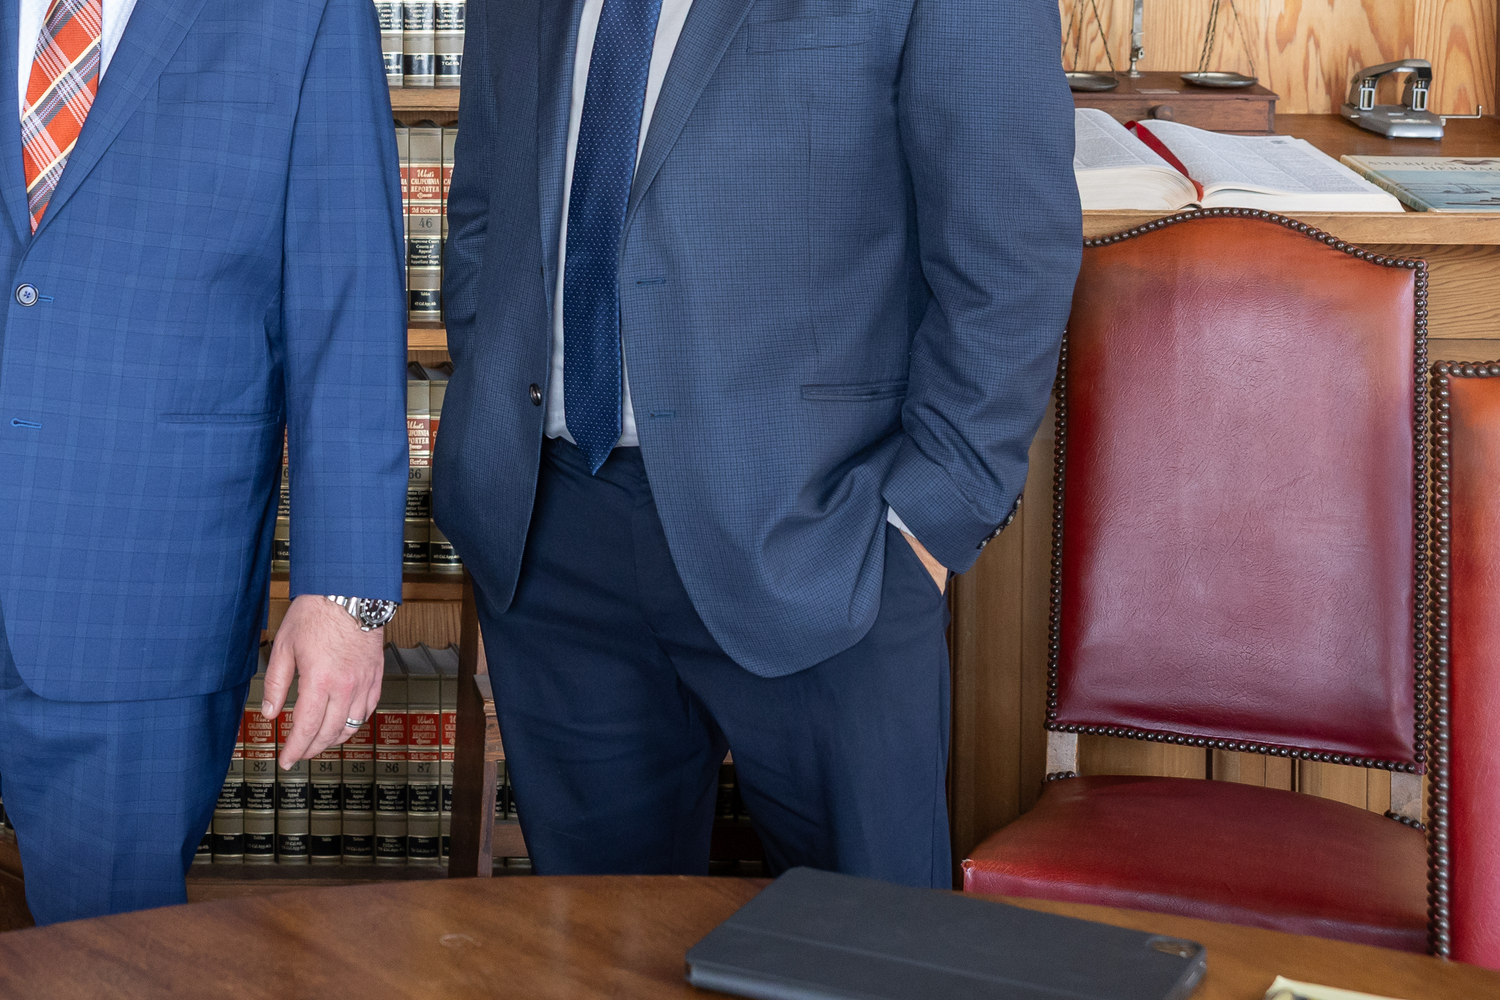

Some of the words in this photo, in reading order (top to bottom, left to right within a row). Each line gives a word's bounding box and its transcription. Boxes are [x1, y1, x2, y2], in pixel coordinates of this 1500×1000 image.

[417, 169, 434, 177] West's
[419, 218, 432, 228] 46
[409, 469, 421, 479] 66
[253, 762, 266, 771] 82
[319, 762, 332, 772] 84
[352, 762, 365, 772] 85
[385, 763, 398, 773] 86
[417, 763, 431, 773] 87
